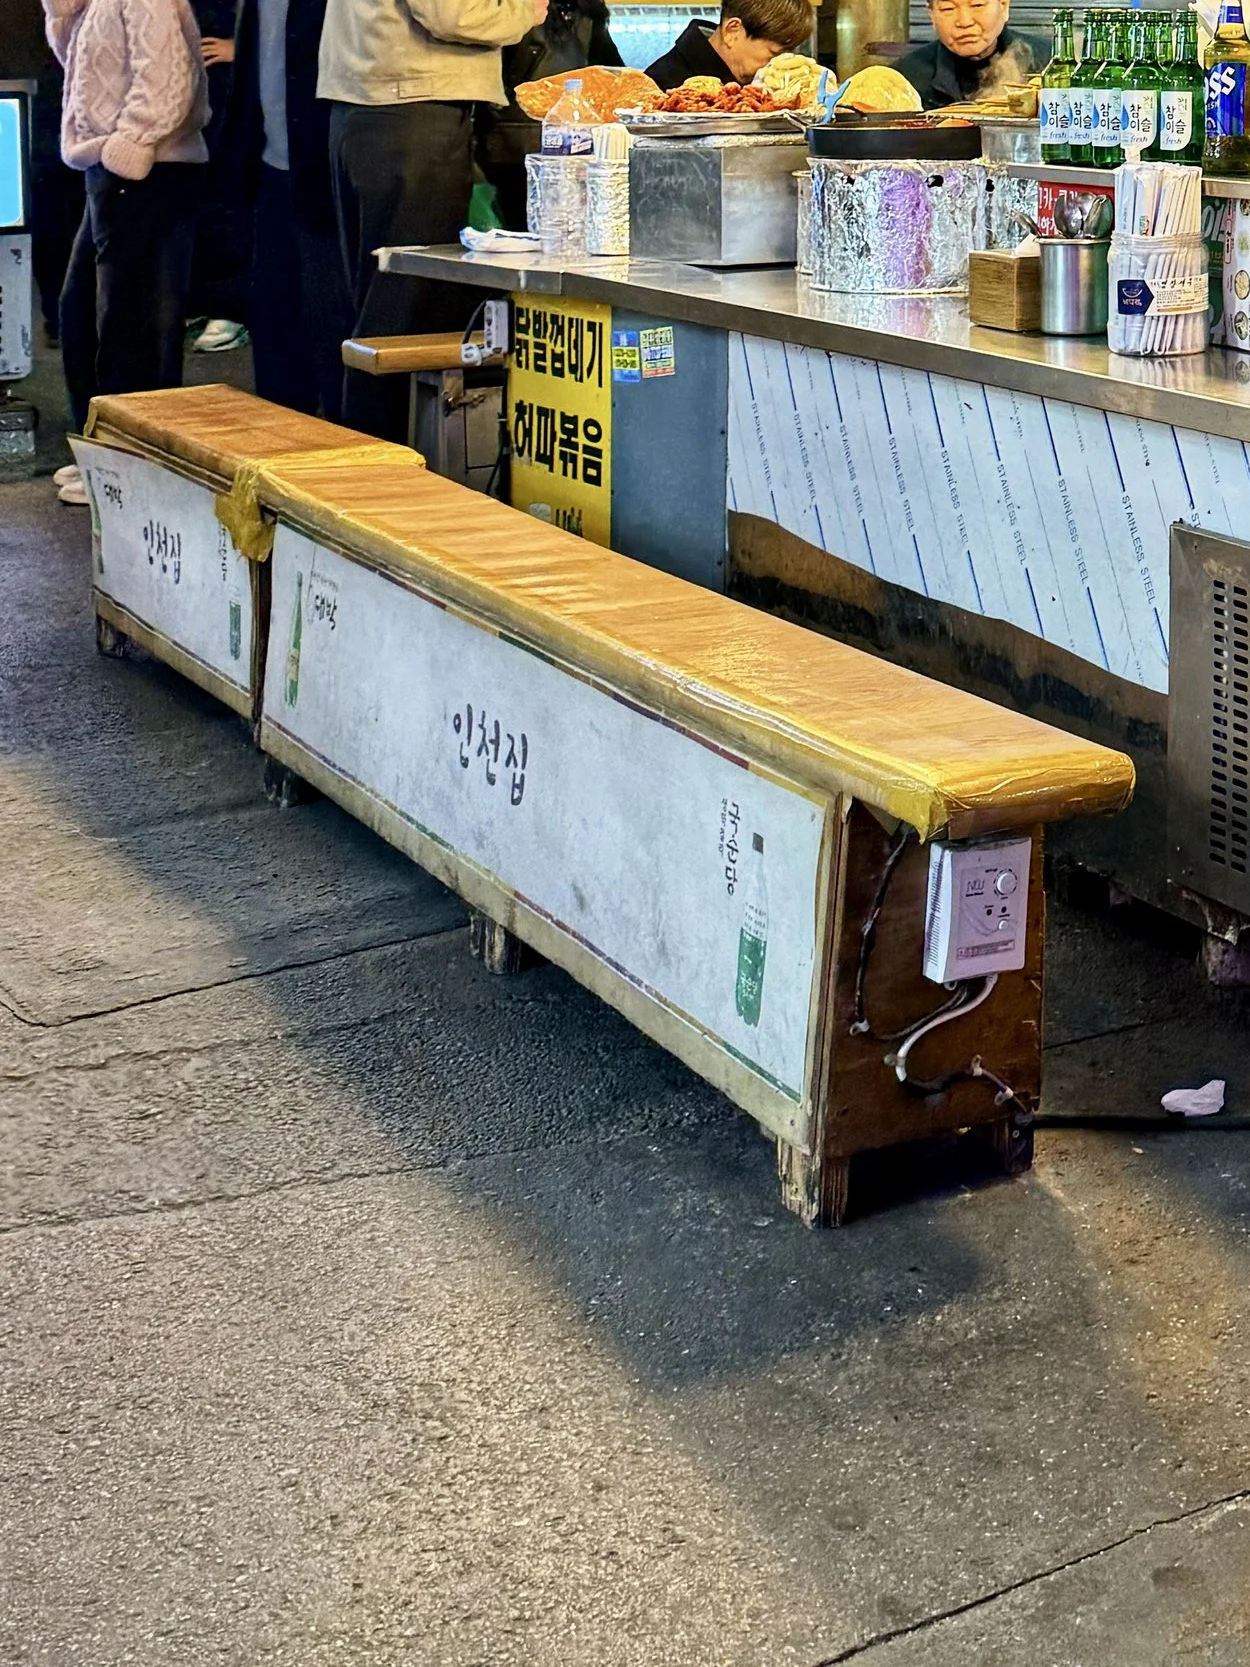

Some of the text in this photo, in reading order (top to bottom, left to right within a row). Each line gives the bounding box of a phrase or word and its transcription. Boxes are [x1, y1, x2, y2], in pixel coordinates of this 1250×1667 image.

[514, 305, 603, 389] 닭발껍데기
[514, 399, 603, 487] 허파볶음
[143, 519, 182, 585] 인천집
[453, 703, 528, 806] 인천집
[725, 801, 741, 897] 국순당
